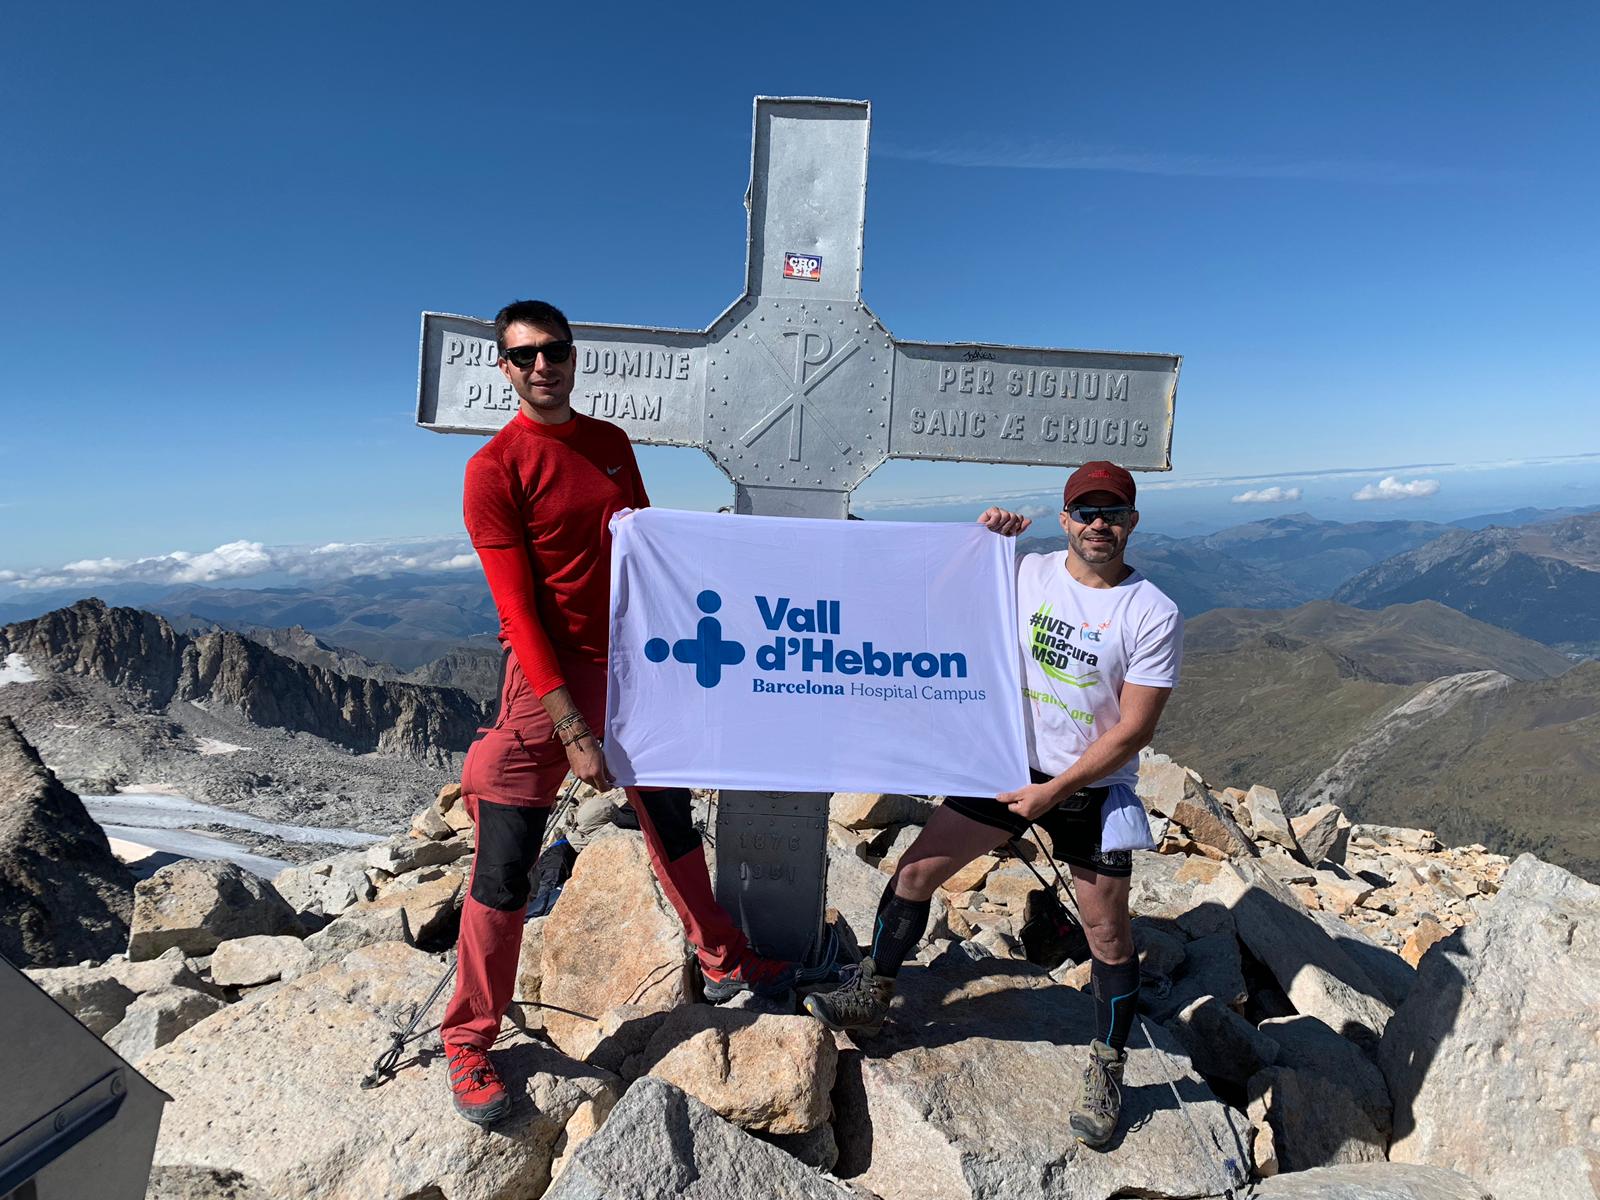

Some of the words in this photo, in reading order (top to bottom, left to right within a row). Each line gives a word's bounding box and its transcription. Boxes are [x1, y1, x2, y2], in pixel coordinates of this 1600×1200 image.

[582, 346, 690, 381] DOMINE
[938, 364, 995, 395] PER
[1006, 369, 1129, 402] SIGNUM
[463, 382, 520, 411] PLE
[585, 391, 662, 422] TUAM
[1040, 415, 1149, 447] CRUCIS
[754, 596, 840, 635] Vall
[1029, 612, 1075, 640] #IVET
[756, 636, 968, 679] d’Hebron
[1031, 644, 1069, 671] MSD
[752, 678, 845, 696] Barcelona
[850, 682, 917, 701] Hospital
[921, 685, 986, 704] Campus
